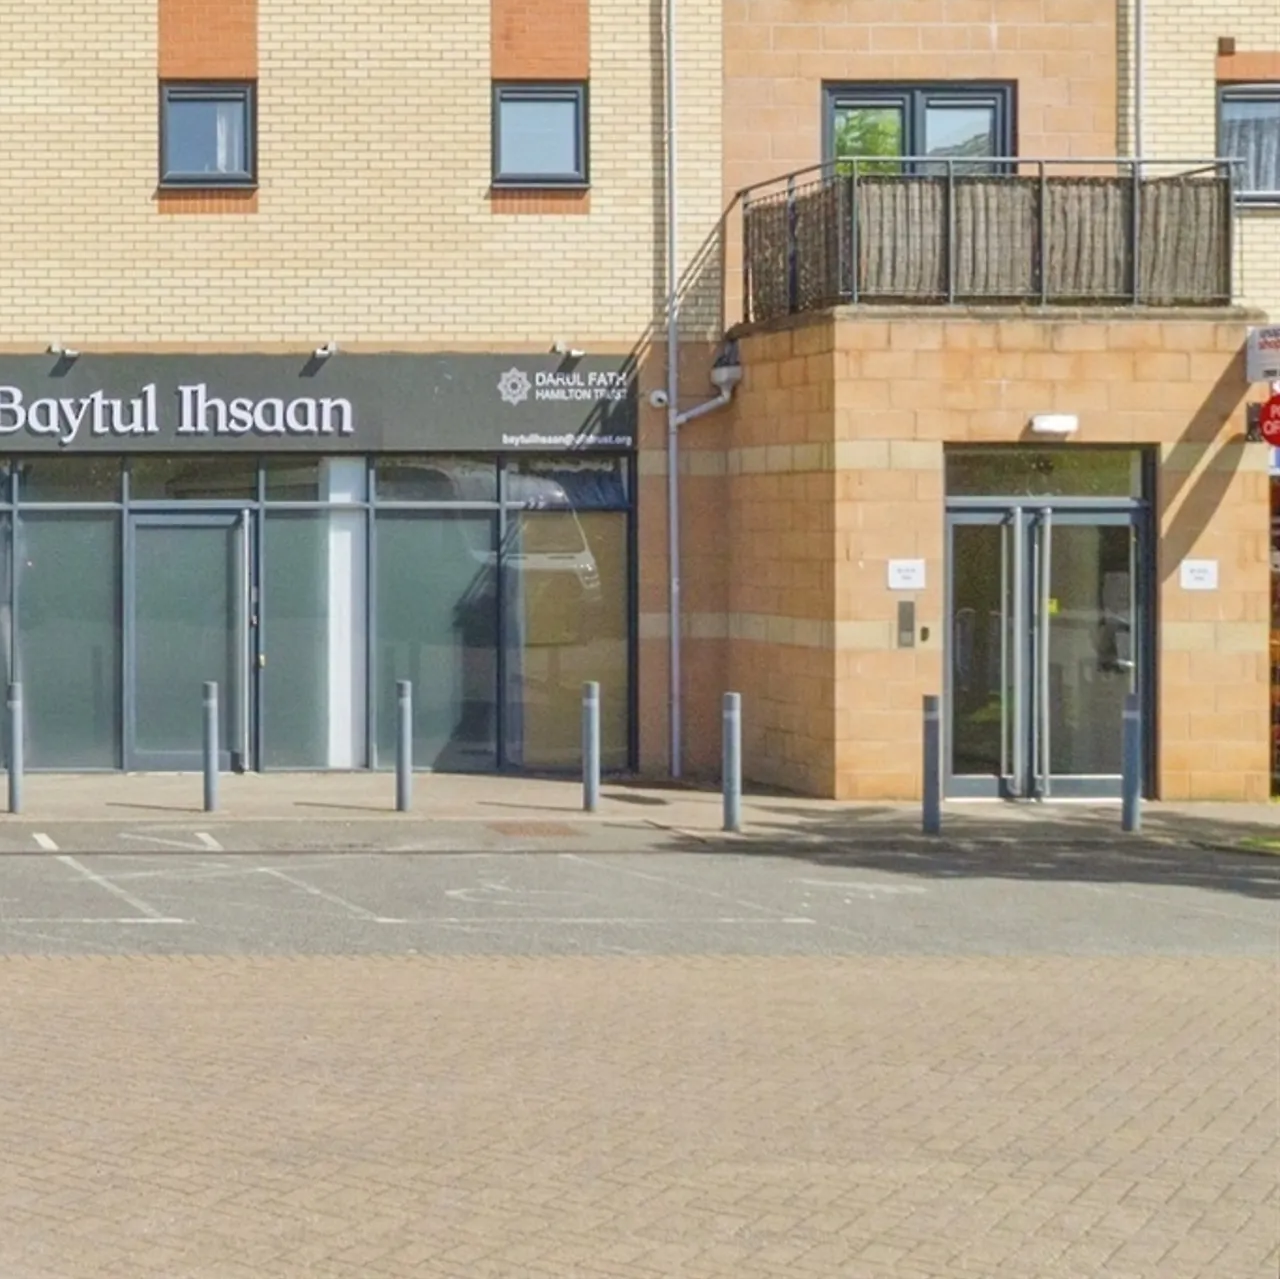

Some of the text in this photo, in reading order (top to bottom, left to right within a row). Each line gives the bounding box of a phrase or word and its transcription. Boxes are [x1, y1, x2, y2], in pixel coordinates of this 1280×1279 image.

[535, 371, 627, 386] DARUL FATH
[535, 389, 627, 400] HAMILTON TRUST
[177, 383, 354, 432] Ihsaan
